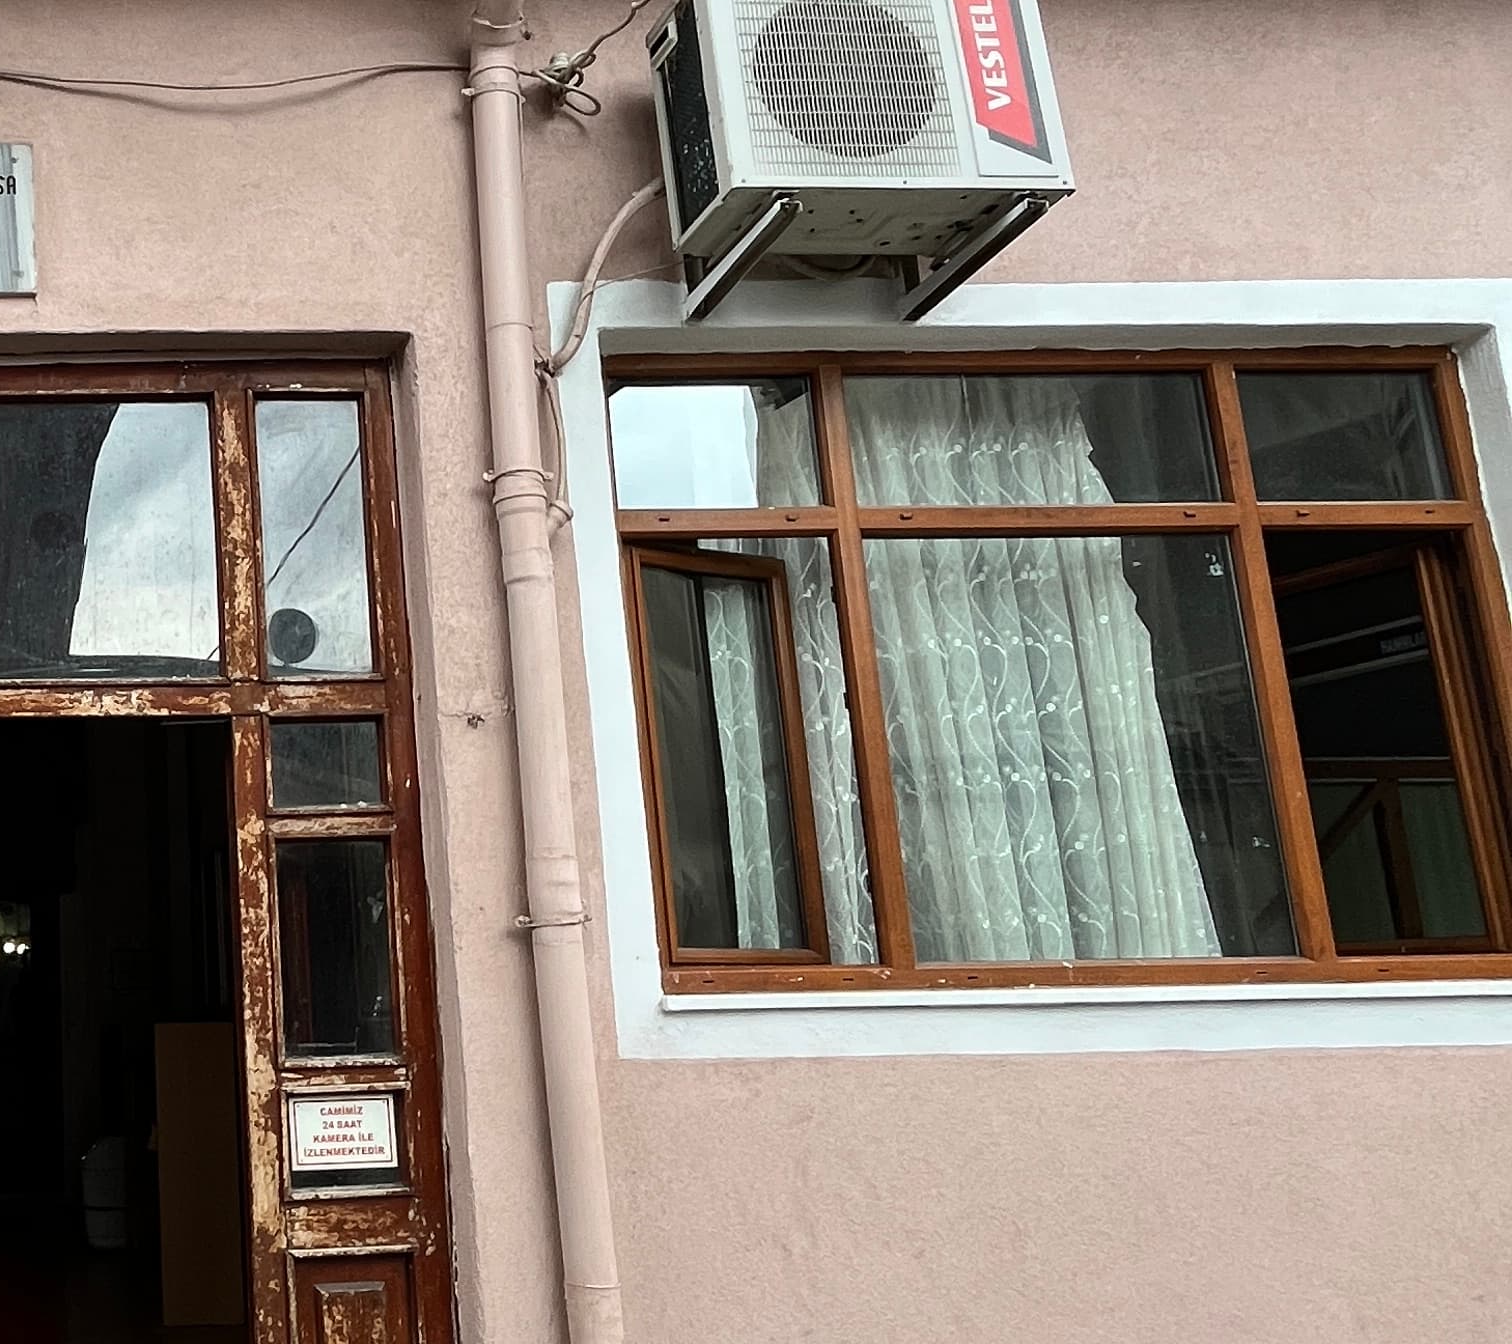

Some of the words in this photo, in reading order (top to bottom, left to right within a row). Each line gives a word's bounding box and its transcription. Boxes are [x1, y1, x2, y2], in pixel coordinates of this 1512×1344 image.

[320, 1104, 364, 1116] CAMİMİZ
[322, 1121, 334, 1130] 24
[337, 1120, 362, 1129] SAAT
[313, 1134, 355, 1143] KAMERA
[358, 1132, 374, 1141] İLE
[304, 1145, 385, 1157] İZLENMEKTEDİR
